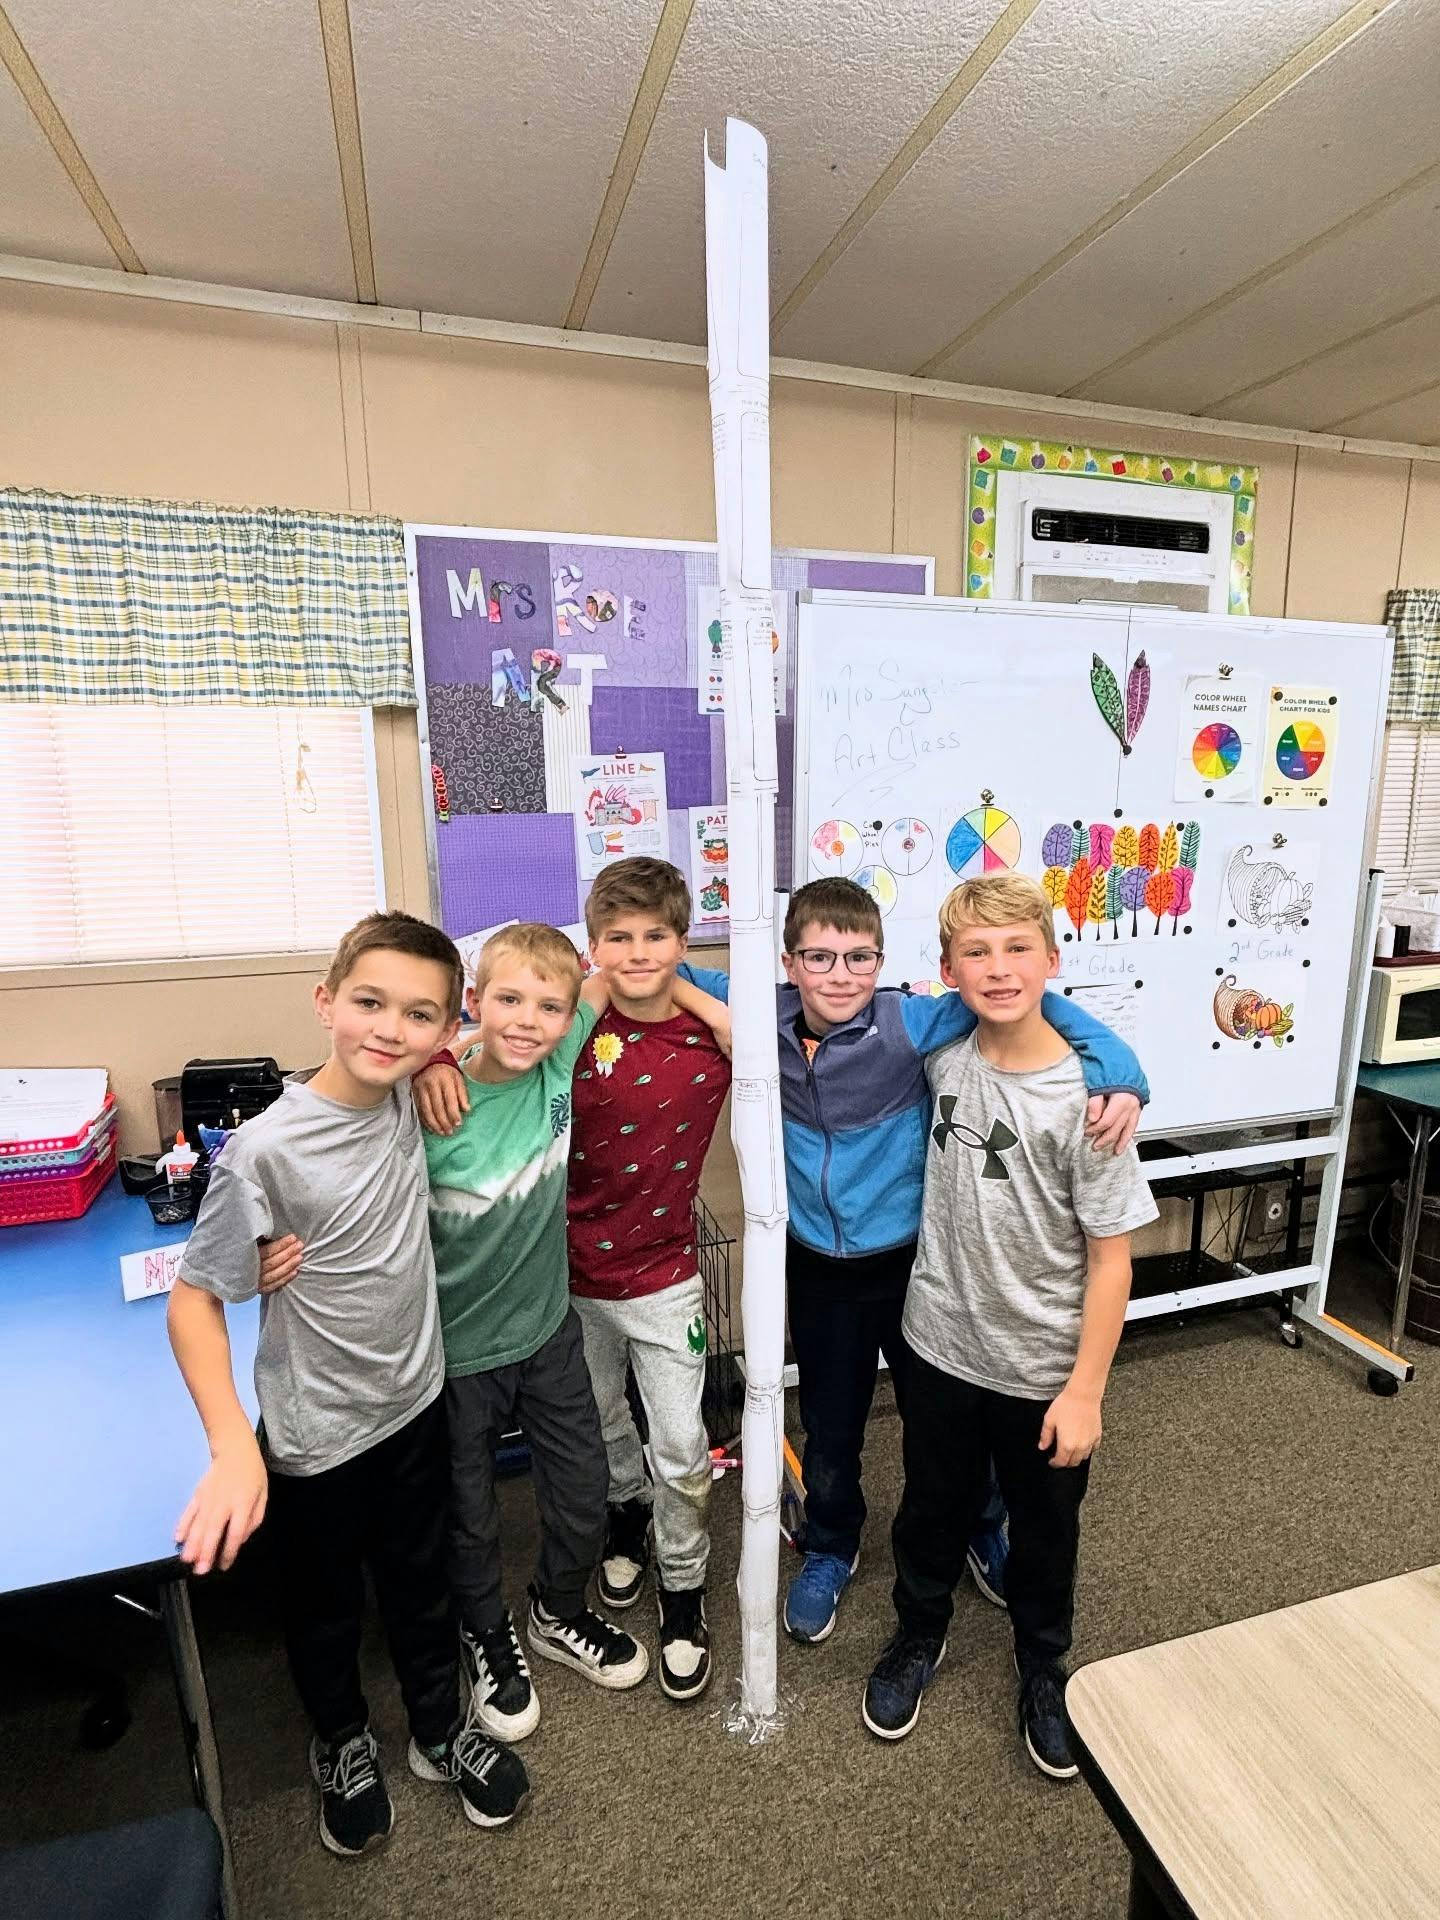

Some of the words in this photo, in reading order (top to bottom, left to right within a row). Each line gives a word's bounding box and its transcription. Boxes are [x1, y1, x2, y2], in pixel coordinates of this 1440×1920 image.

[491, 647, 609, 715] ART
[1193, 703, 1220, 712] NAMES
[1221, 705, 1248, 713] CHART
[1194, 693, 1221, 702] COLOR
[1222, 694, 1247, 703] WHEEL
[834, 733, 876, 774] Art
[887, 726, 961, 762] Class
[602, 763, 636, 776] LINE
[1257, 939, 1294, 960] Grade
[1088, 955, 1136, 976] Grade
